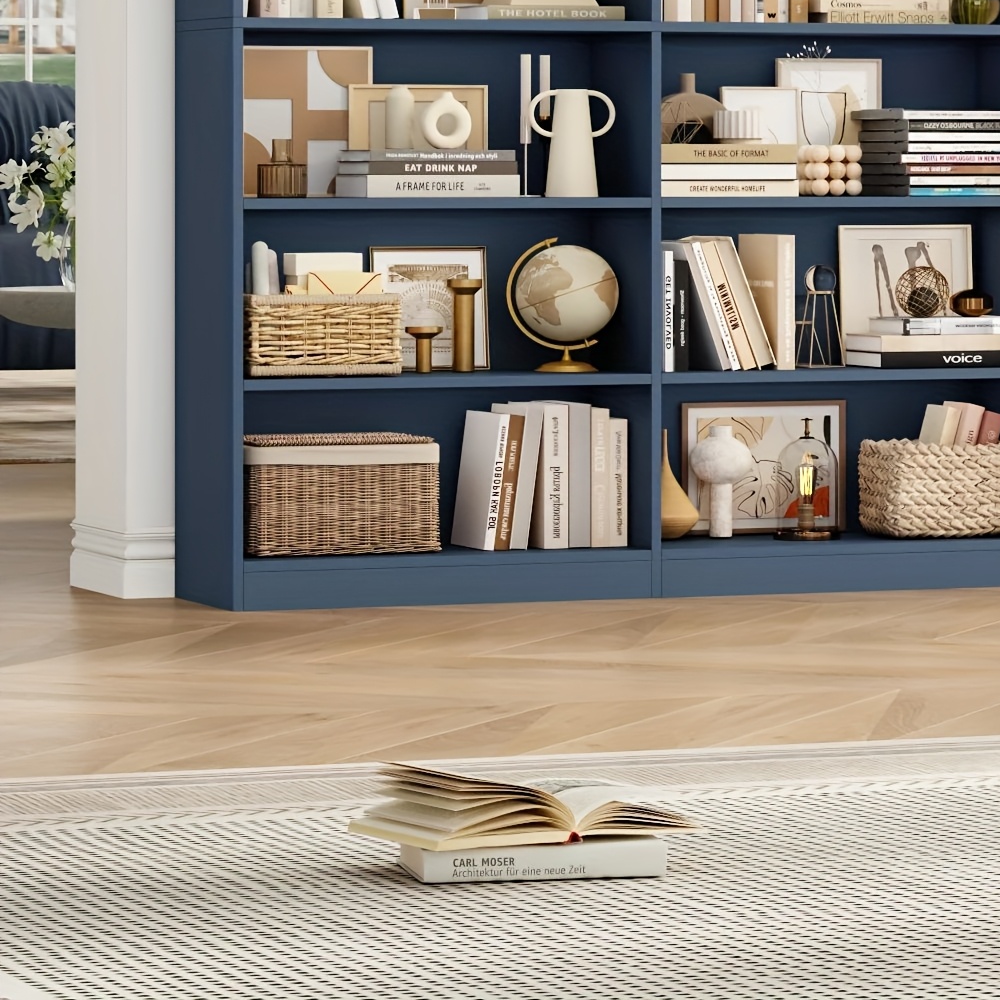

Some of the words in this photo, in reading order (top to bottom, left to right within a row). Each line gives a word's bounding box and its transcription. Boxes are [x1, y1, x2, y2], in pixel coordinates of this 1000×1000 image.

[830, 0, 862, 8] Cosmos
[499, 8, 522, 17] THE
[526, 8, 568, 18] HOTEL
[570, 10, 608, 18] BOOK
[830, 11, 860, 24] Elliott
[864, 11, 895, 24] Erwitt
[897, 12, 934, 24] Snaps
[708, 150, 728, 158] BASIC
[730, 150, 739, 158] OF
[741, 150, 769, 158] FORMAT
[404, 164, 422, 172] EAT
[425, 164, 455, 172] DRINK
[458, 164, 478, 172] NAP
[396, 181, 401, 192] A
[402, 181, 430, 192] FRAME
[432, 181, 446, 192] FOR
[448, 181, 464, 192] LIFE
[942, 352, 983, 364] voice
[453, 858, 478, 868] CARL
[481, 856, 516, 867] MOSER
[452, 866, 504, 878] Architektur
[506, 866, 519, 876] für
[522, 866, 542, 876] eine
[544, 867, 566, 876] neue
[568, 864, 586, 875] Zeit
